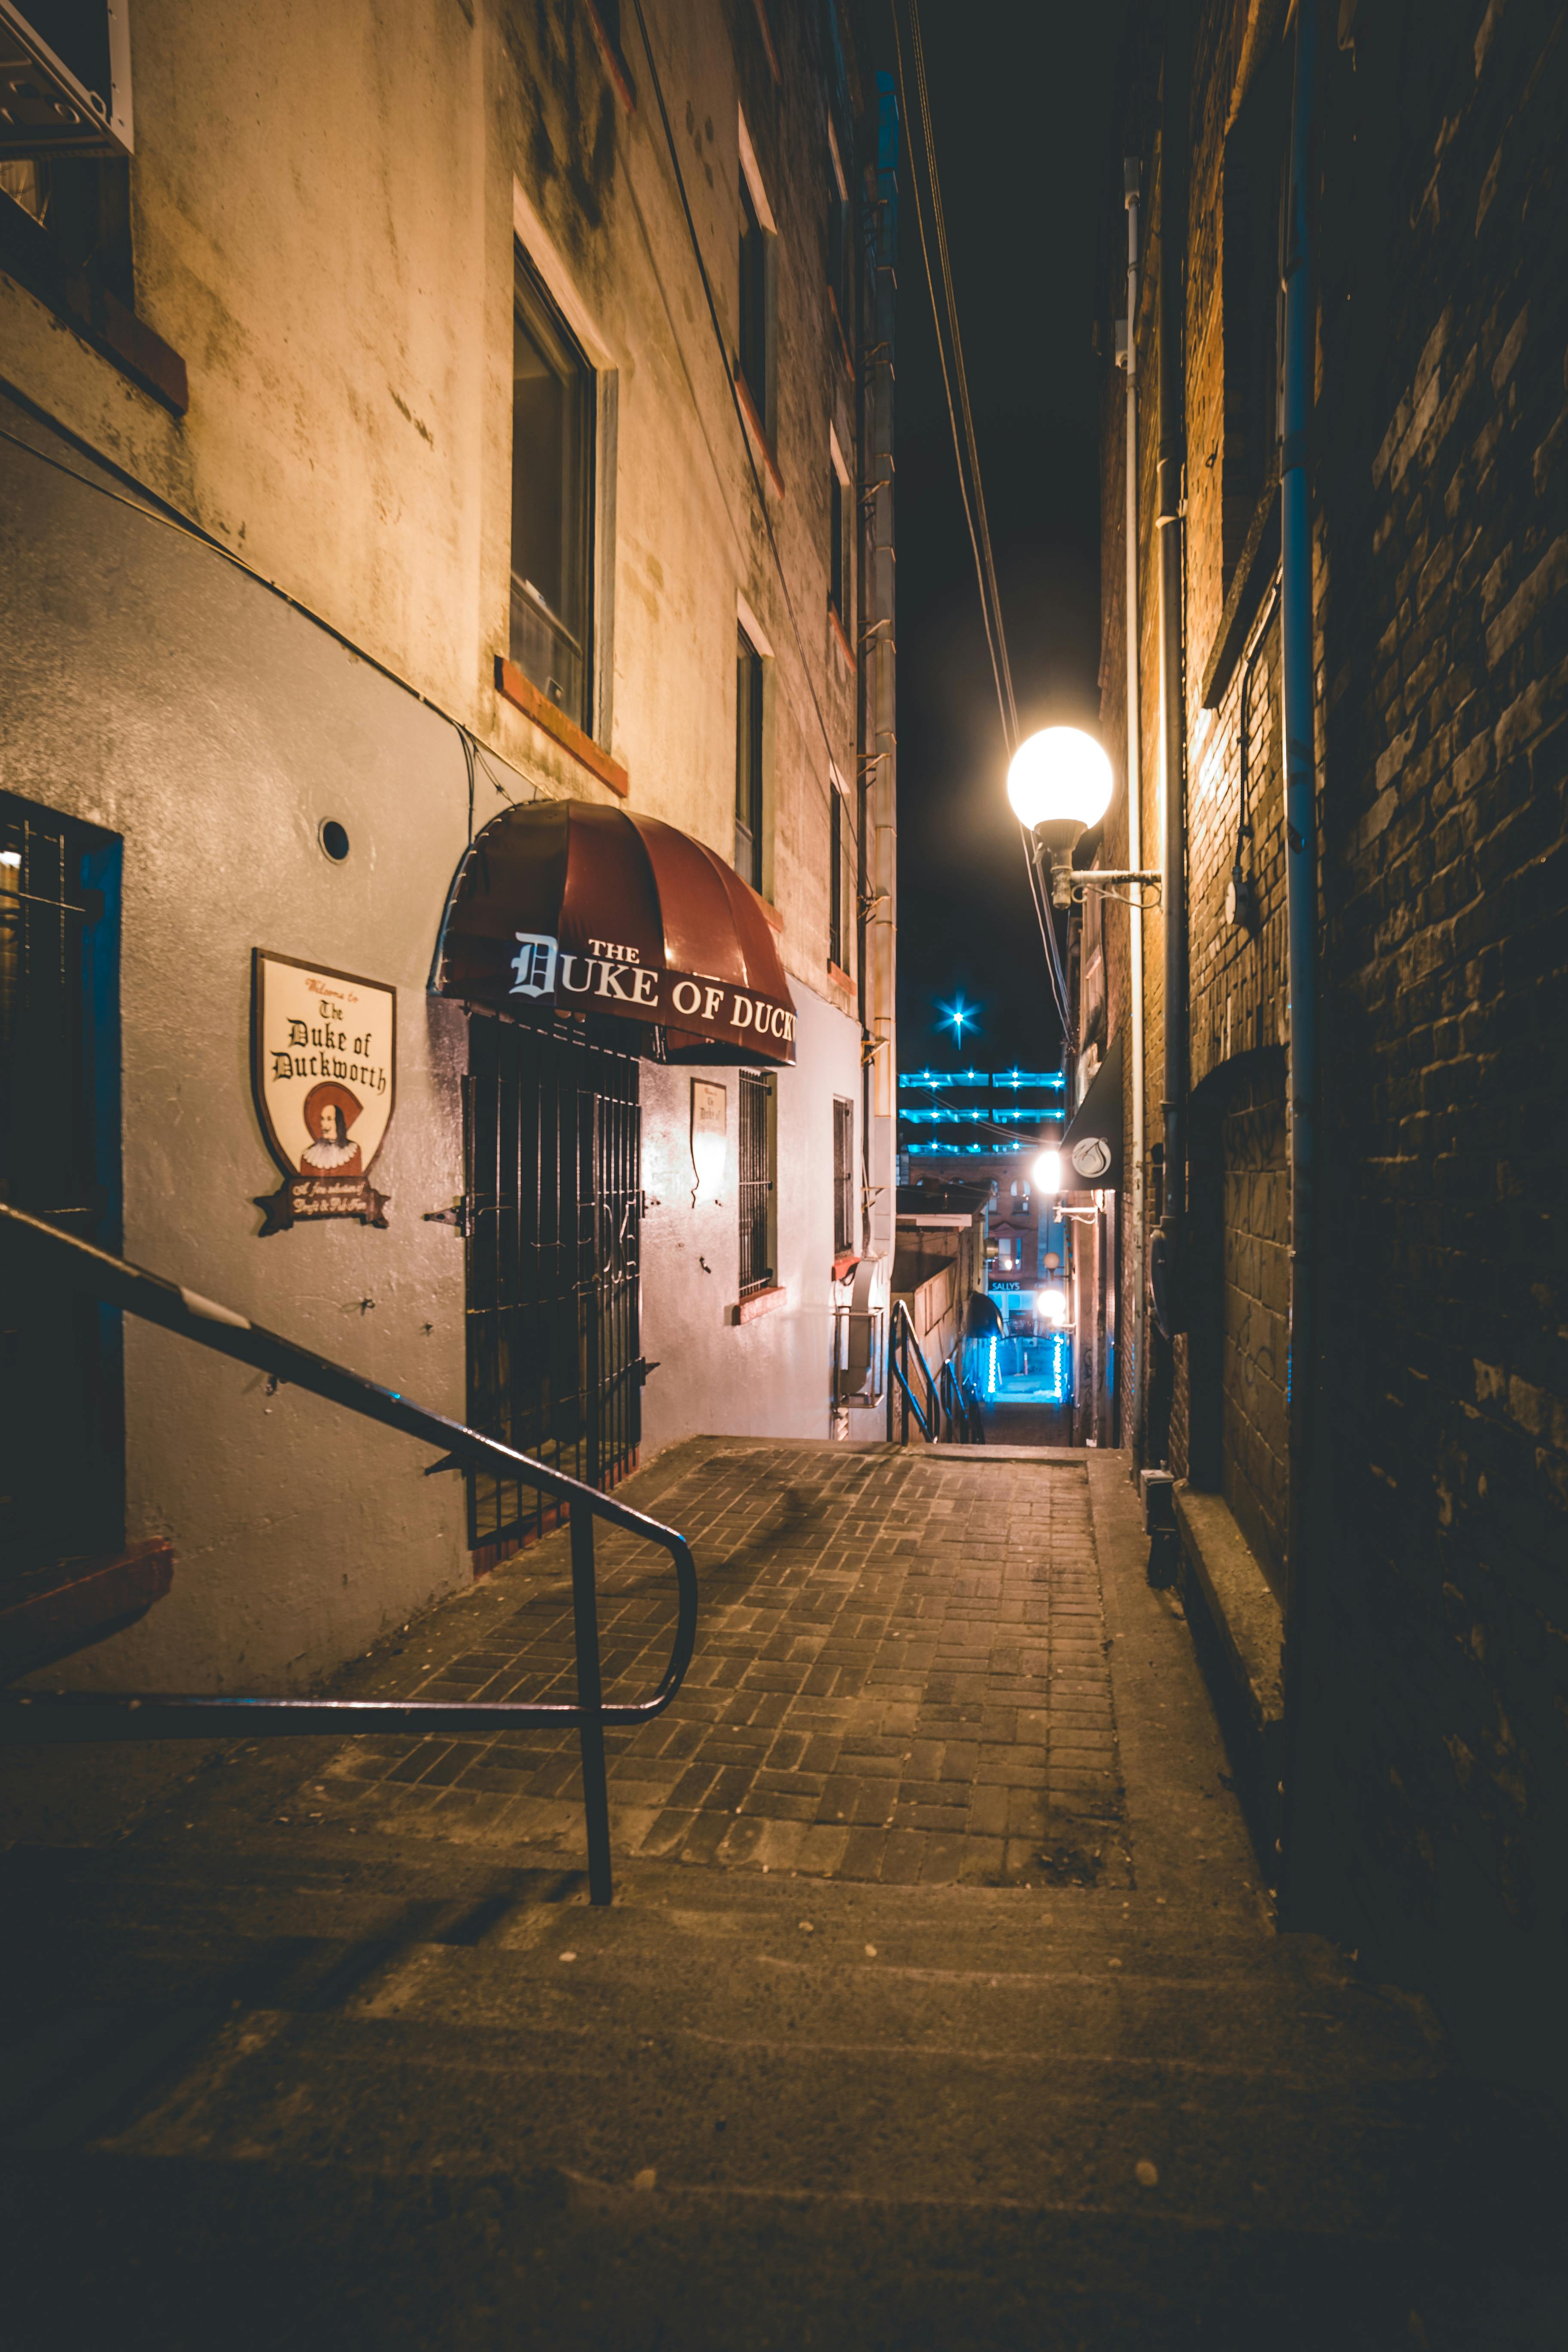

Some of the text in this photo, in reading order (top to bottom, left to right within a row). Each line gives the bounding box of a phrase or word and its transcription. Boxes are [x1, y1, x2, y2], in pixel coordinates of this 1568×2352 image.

[588, 938, 640, 964] THE
[508, 931, 659, 1007] DUKE
[672, 981, 724, 1020] OF
[318, 999, 343, 1020] The
[347, 991, 358, 1003] to
[286, 1017, 371, 1057] Duke of
[270, 1050, 386, 1096] Duckworth
